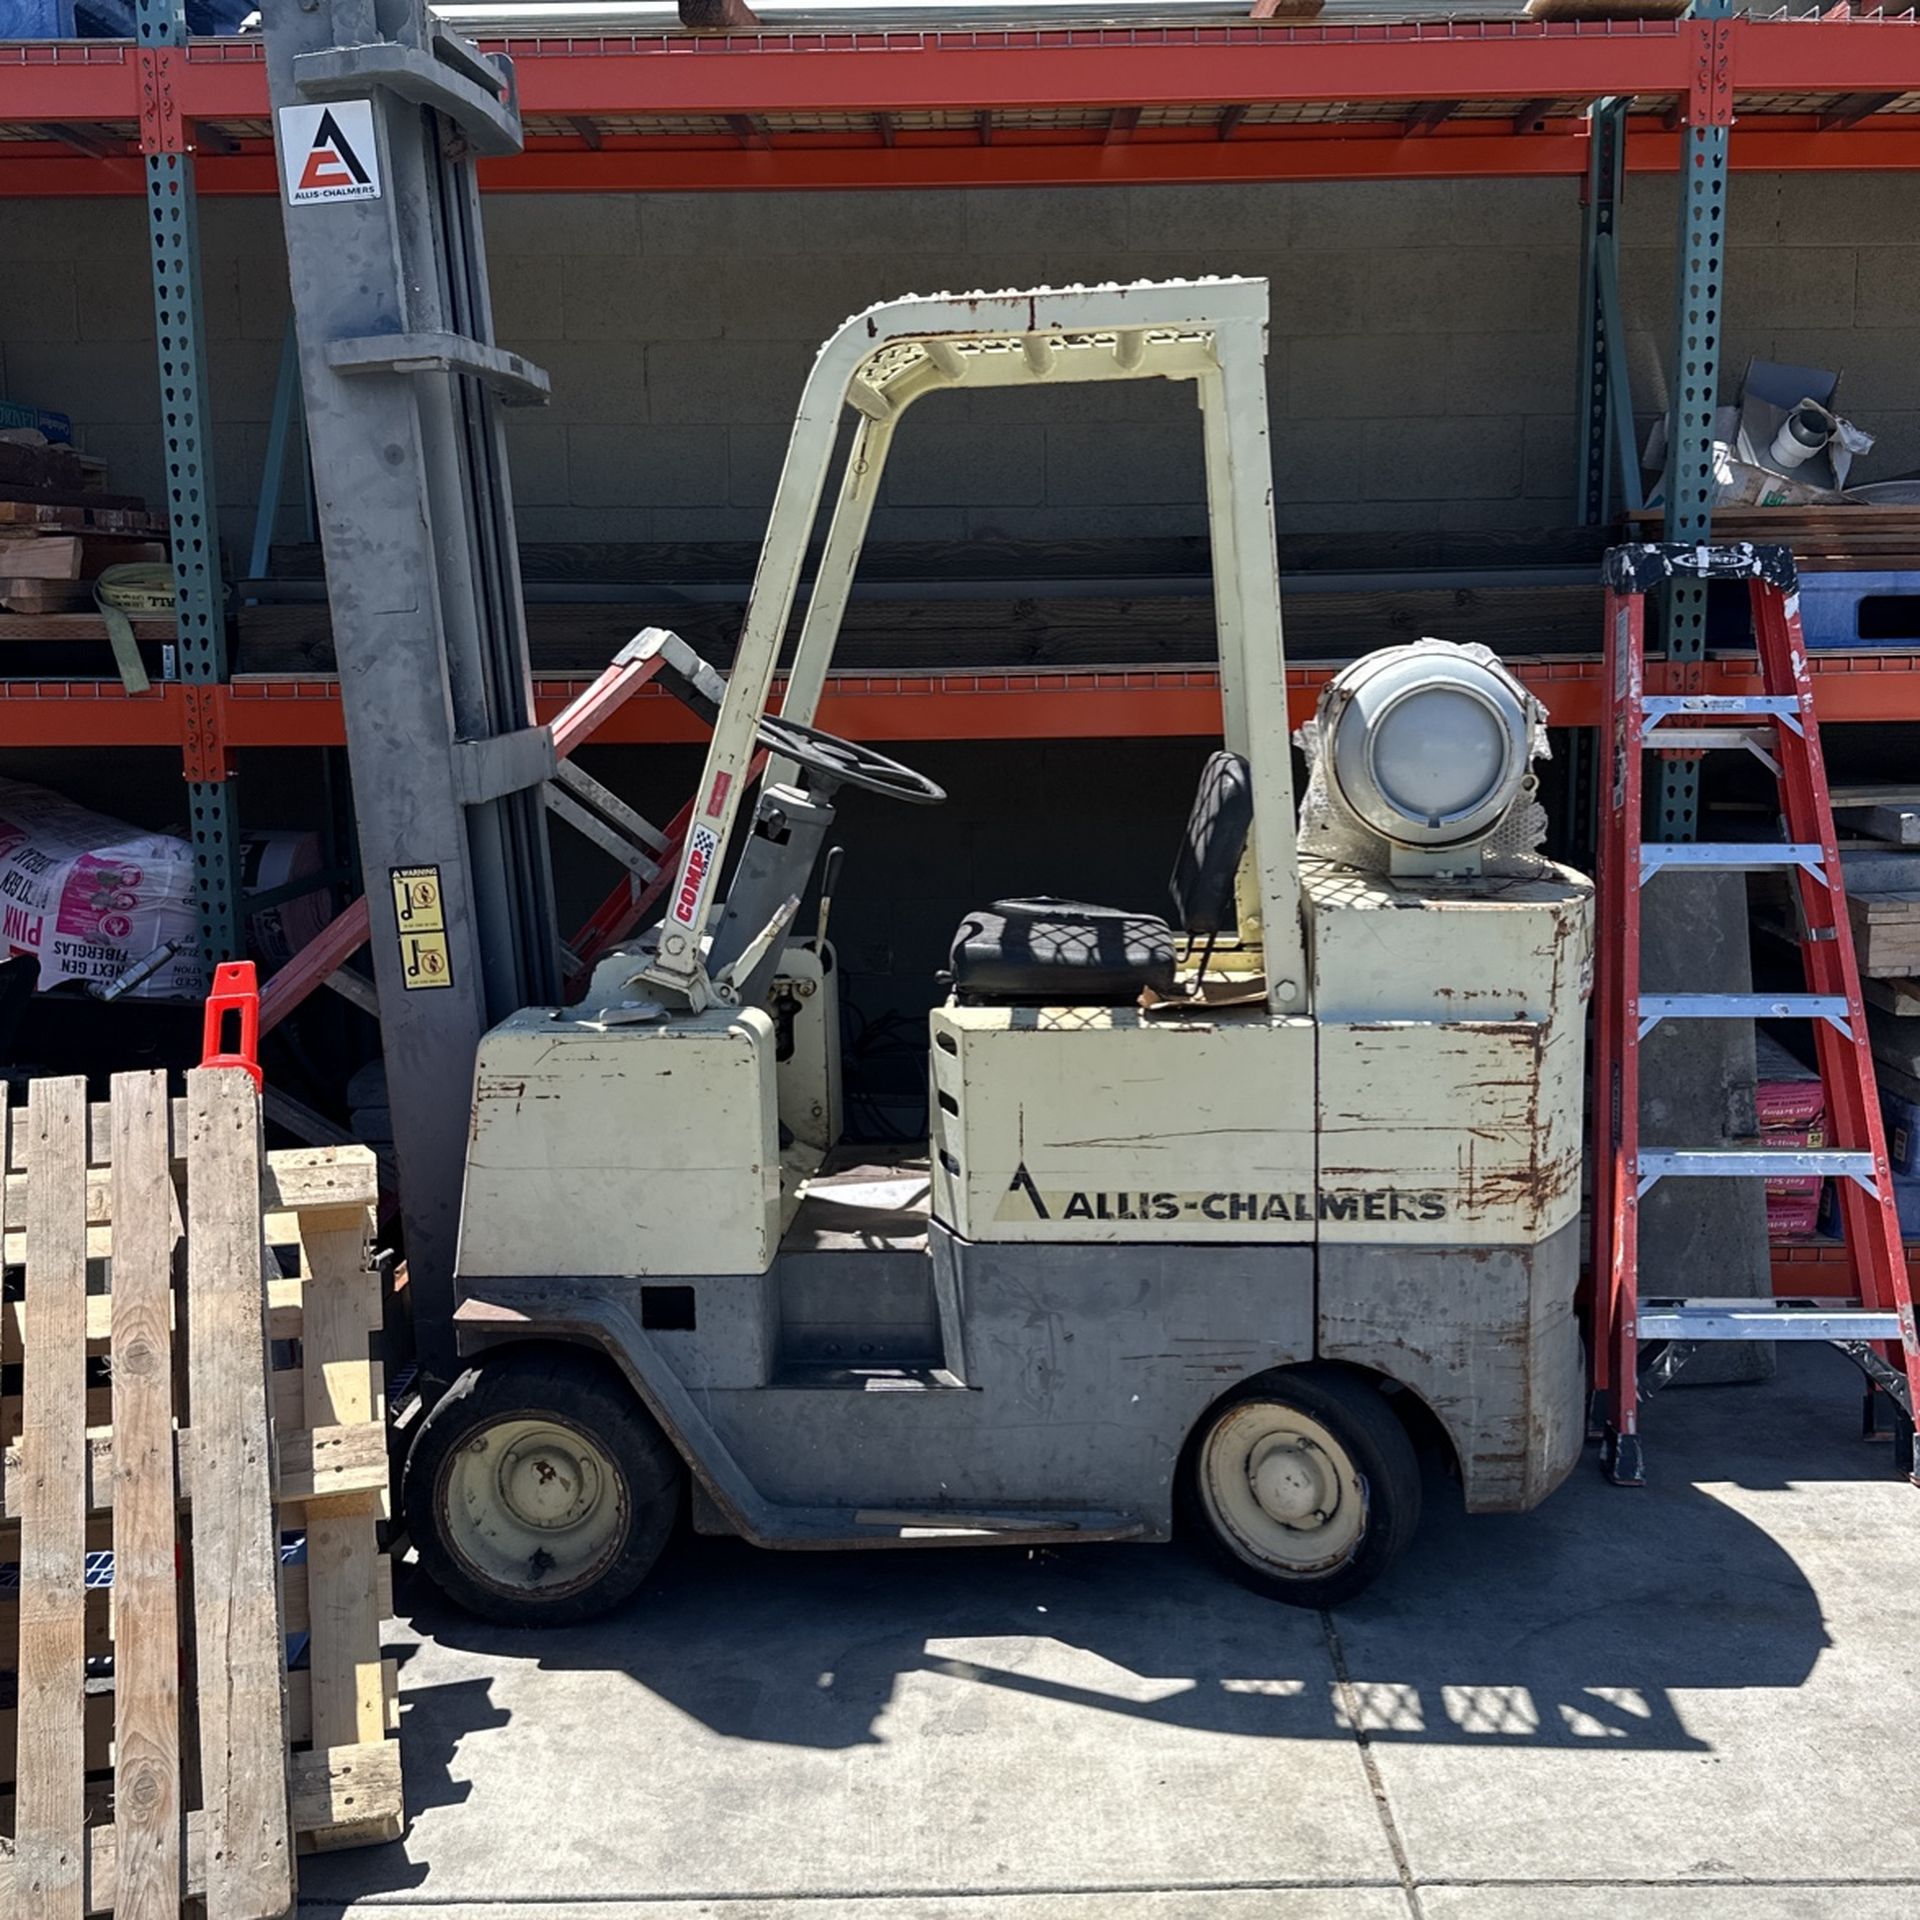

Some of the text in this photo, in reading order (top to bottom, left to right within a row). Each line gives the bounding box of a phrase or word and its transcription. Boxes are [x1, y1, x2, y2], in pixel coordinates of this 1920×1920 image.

[295, 185, 375, 200] ALLIS-CHALMERS
[401, 866, 438, 877] WARNING
[675, 849, 704, 923] COMP
[3, 904, 43, 947] PINK
[53, 940, 128, 963] FIBERGLAS
[60, 958, 87, 976] GEN
[1766, 1138, 1801, 1148] Setting
[1063, 1191, 1447, 1222] ALLIS-CHALMERS
